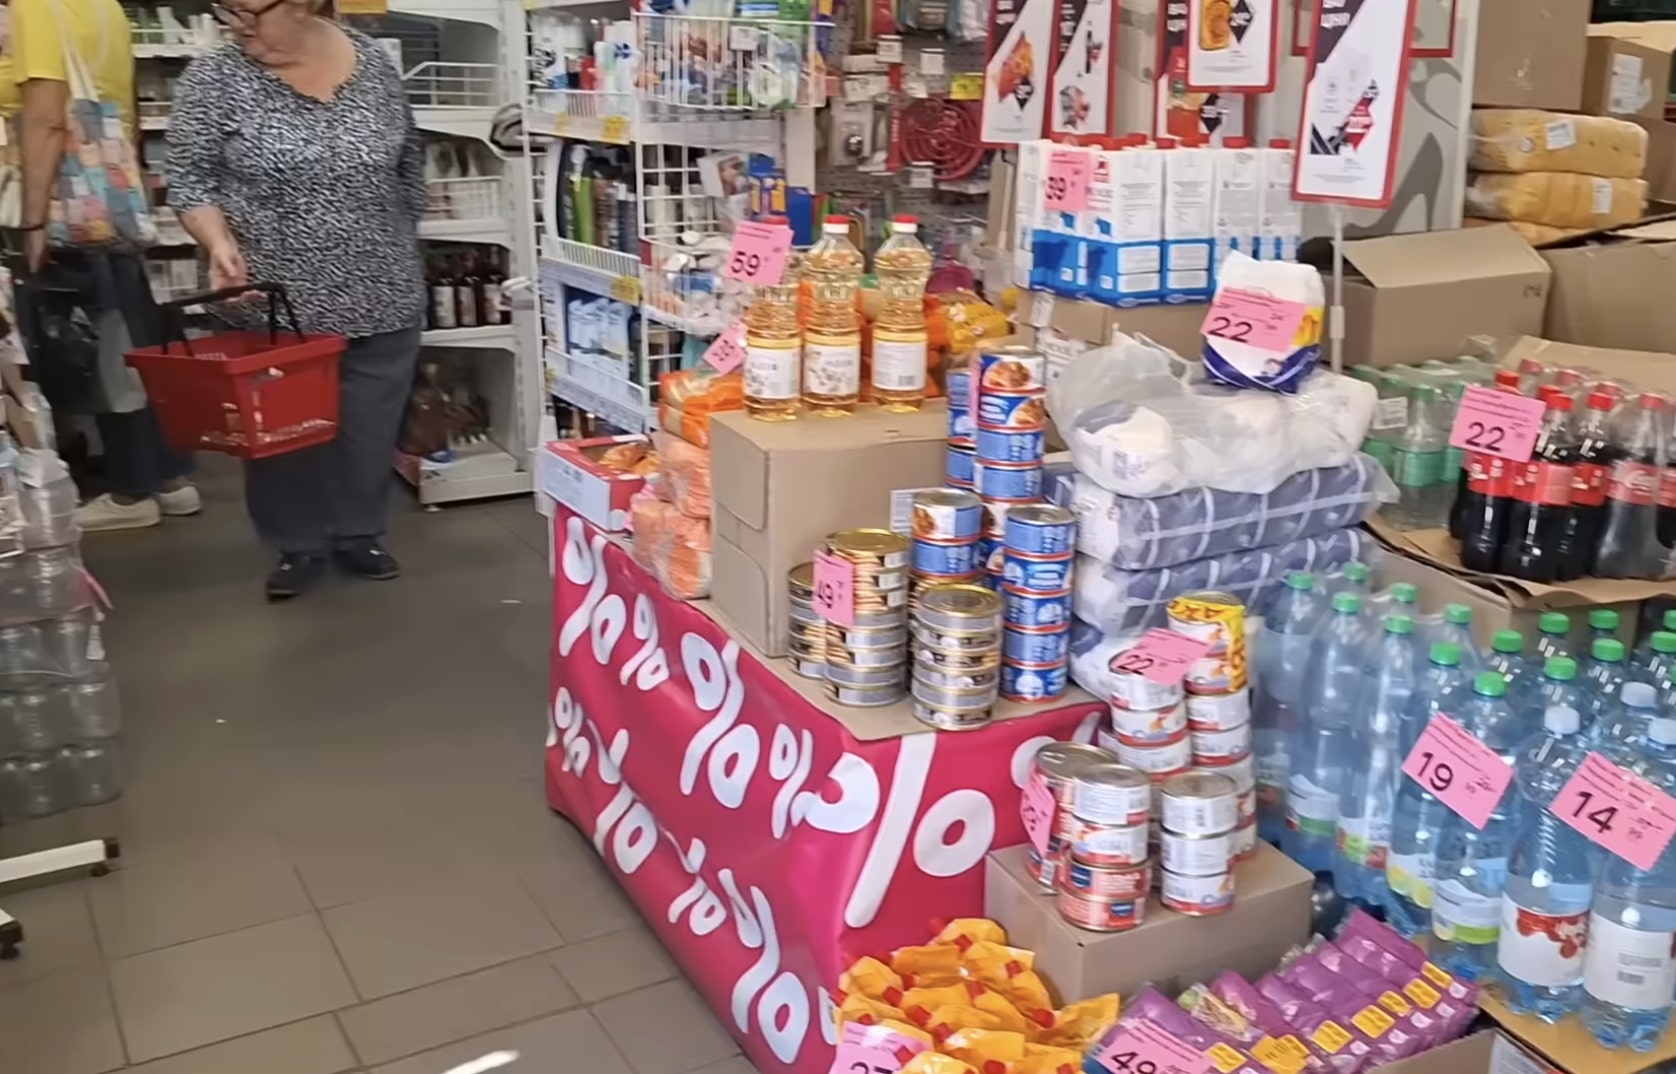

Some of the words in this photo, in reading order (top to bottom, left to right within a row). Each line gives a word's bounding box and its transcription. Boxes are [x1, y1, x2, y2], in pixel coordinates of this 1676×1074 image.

[731, 250, 761, 277] 59
[1207, 316, 1253, 344] 22
[1465, 421, 1505, 452] 22
[1117, 654, 1154, 675] 22
[1418, 752, 1454, 792] 19
[1572, 791, 1618, 833] 14
